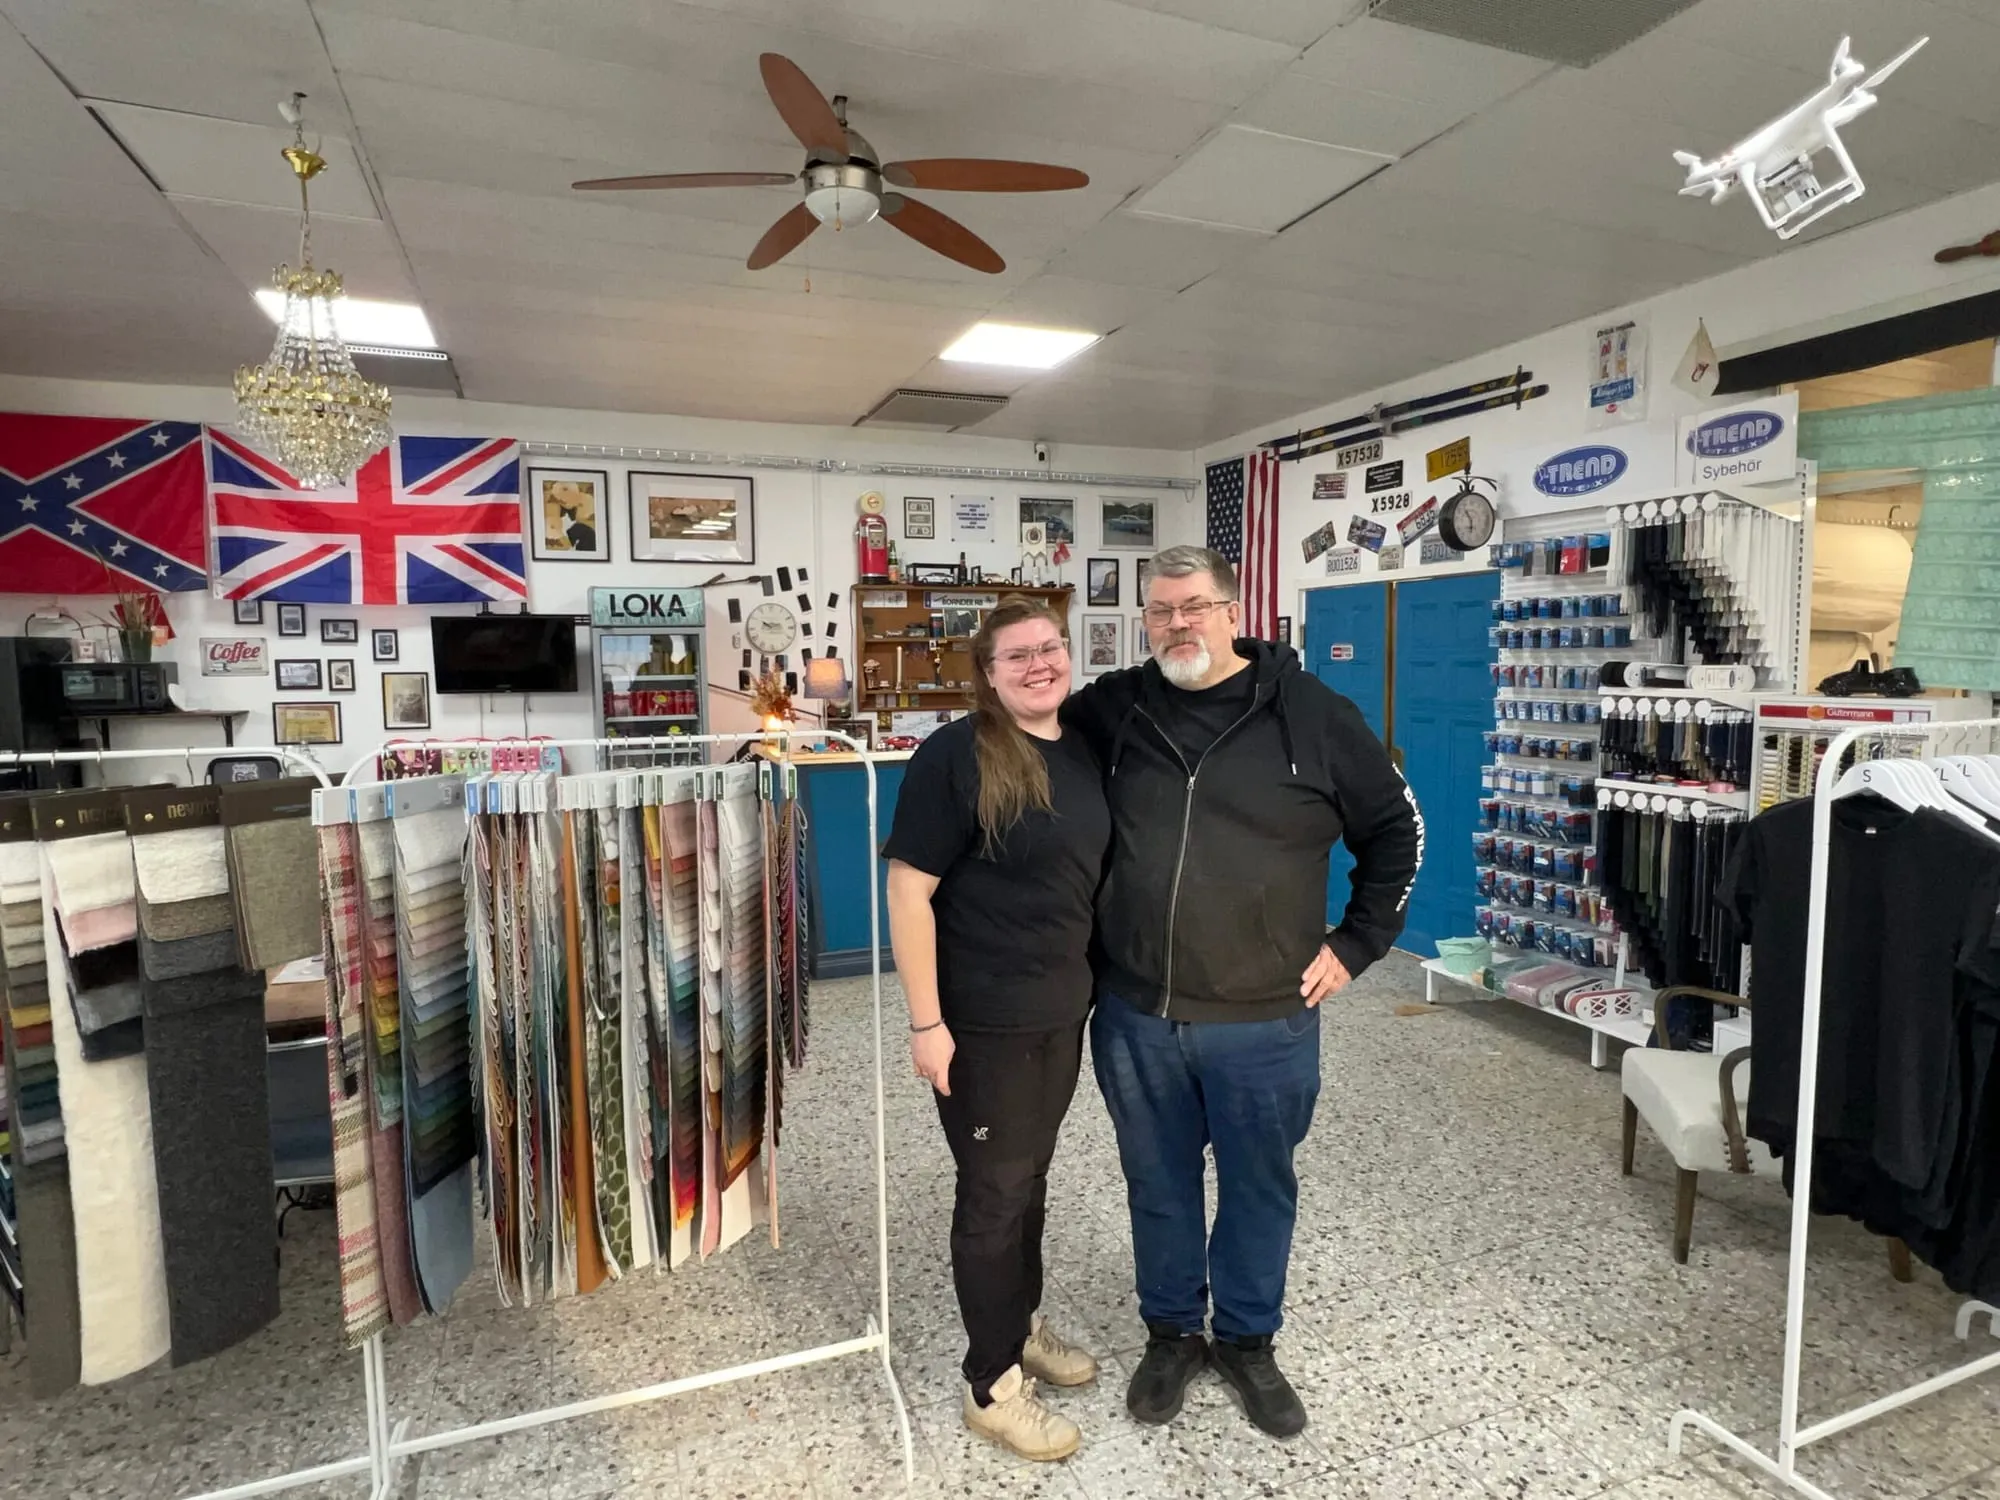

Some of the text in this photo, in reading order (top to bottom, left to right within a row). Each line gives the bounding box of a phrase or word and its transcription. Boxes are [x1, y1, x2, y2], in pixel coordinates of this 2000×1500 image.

[1701, 418, 1772, 448] TREND
[1547, 454, 1617, 485] TREND
[1703, 459, 1762, 481] Sybehör
[1371, 493, 1410, 513] X5928
[609, 593, 687, 617] LOKA
[209, 641, 260, 664] Coffee
[1827, 707, 1874, 718] Gütermann
[1862, 769, 1872, 783] S
